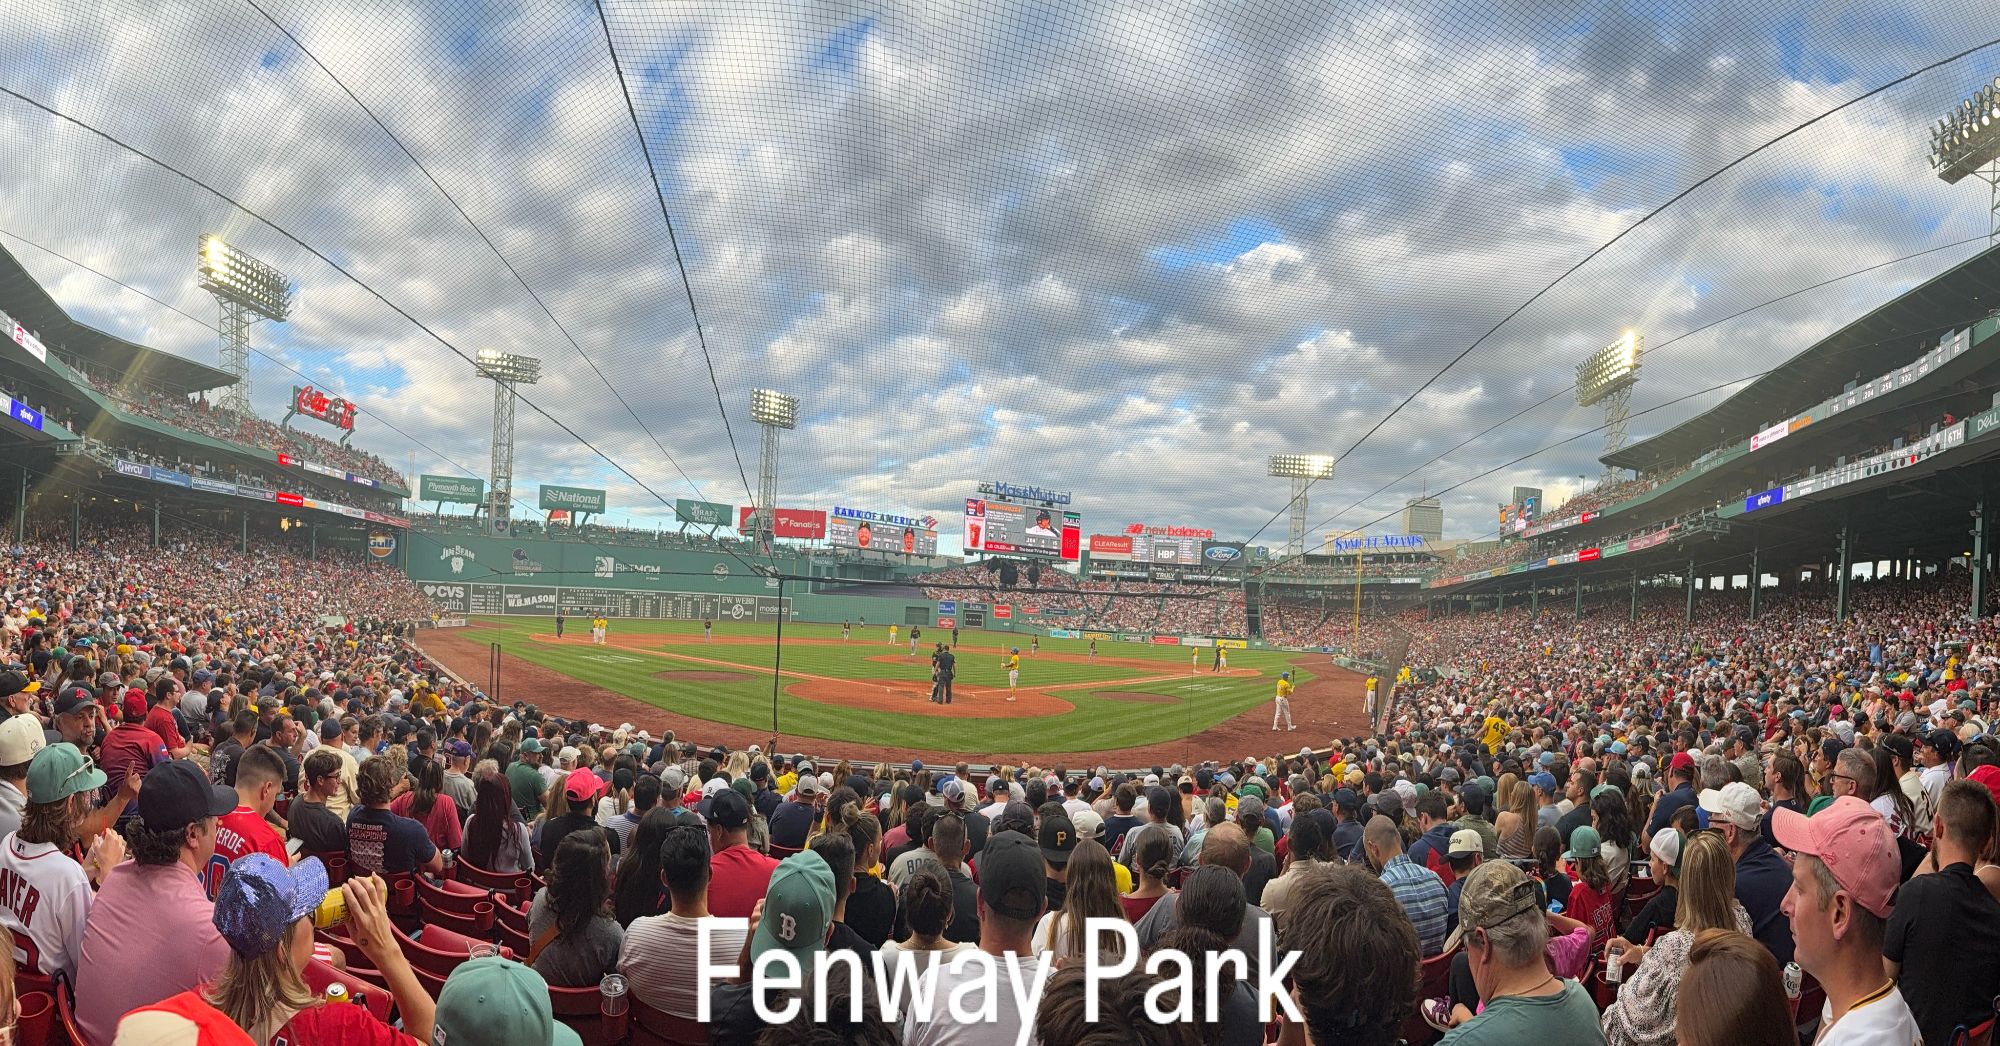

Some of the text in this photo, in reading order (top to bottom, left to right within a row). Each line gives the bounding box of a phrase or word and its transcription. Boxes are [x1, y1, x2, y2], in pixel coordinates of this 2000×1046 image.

[1953, 343, 1960, 353] 15
[1899, 373, 1912, 385] .322
[1880, 381, 1893, 392] .258
[20, 408, 33, 423] xfinity
[1977, 412, 1999, 431] DELL
[1947, 427, 1962, 444] 6TH
[124, 464, 143, 474] HYCU
[428, 482, 477, 493] Plymouth Rock
[995, 480, 1072, 505] MassMutual
[557, 491, 601, 504] National
[1757, 495, 1772, 506] xfinity
[694, 515, 718, 523] KINGS
[834, 506, 920, 527] BANK OF AMERICA
[789, 520, 820, 529] Fanatics
[1145, 525, 1212, 539] new balance
[368, 538, 394, 548] Gulf
[1094, 541, 1128, 549] CLEAResult
[1384, 535, 1423, 548] ADAMS
[440, 545, 475, 561] JIM BEAM
[1157, 550, 1175, 559] HBP
[1211, 549, 1234, 559] Ford
[615, 563, 660, 574] BETMGM
[437, 585, 465, 598] CVS
[735, 597, 755, 605] WEBB
[1493, 721, 1506, 736] 45
[707, 786, 713, 794] B
[352, 822, 367, 830] WORLD
[348, 828, 388, 841] CHAMPIONS
[1057, 831, 1067, 847] P
[779, 912, 797, 941] B
